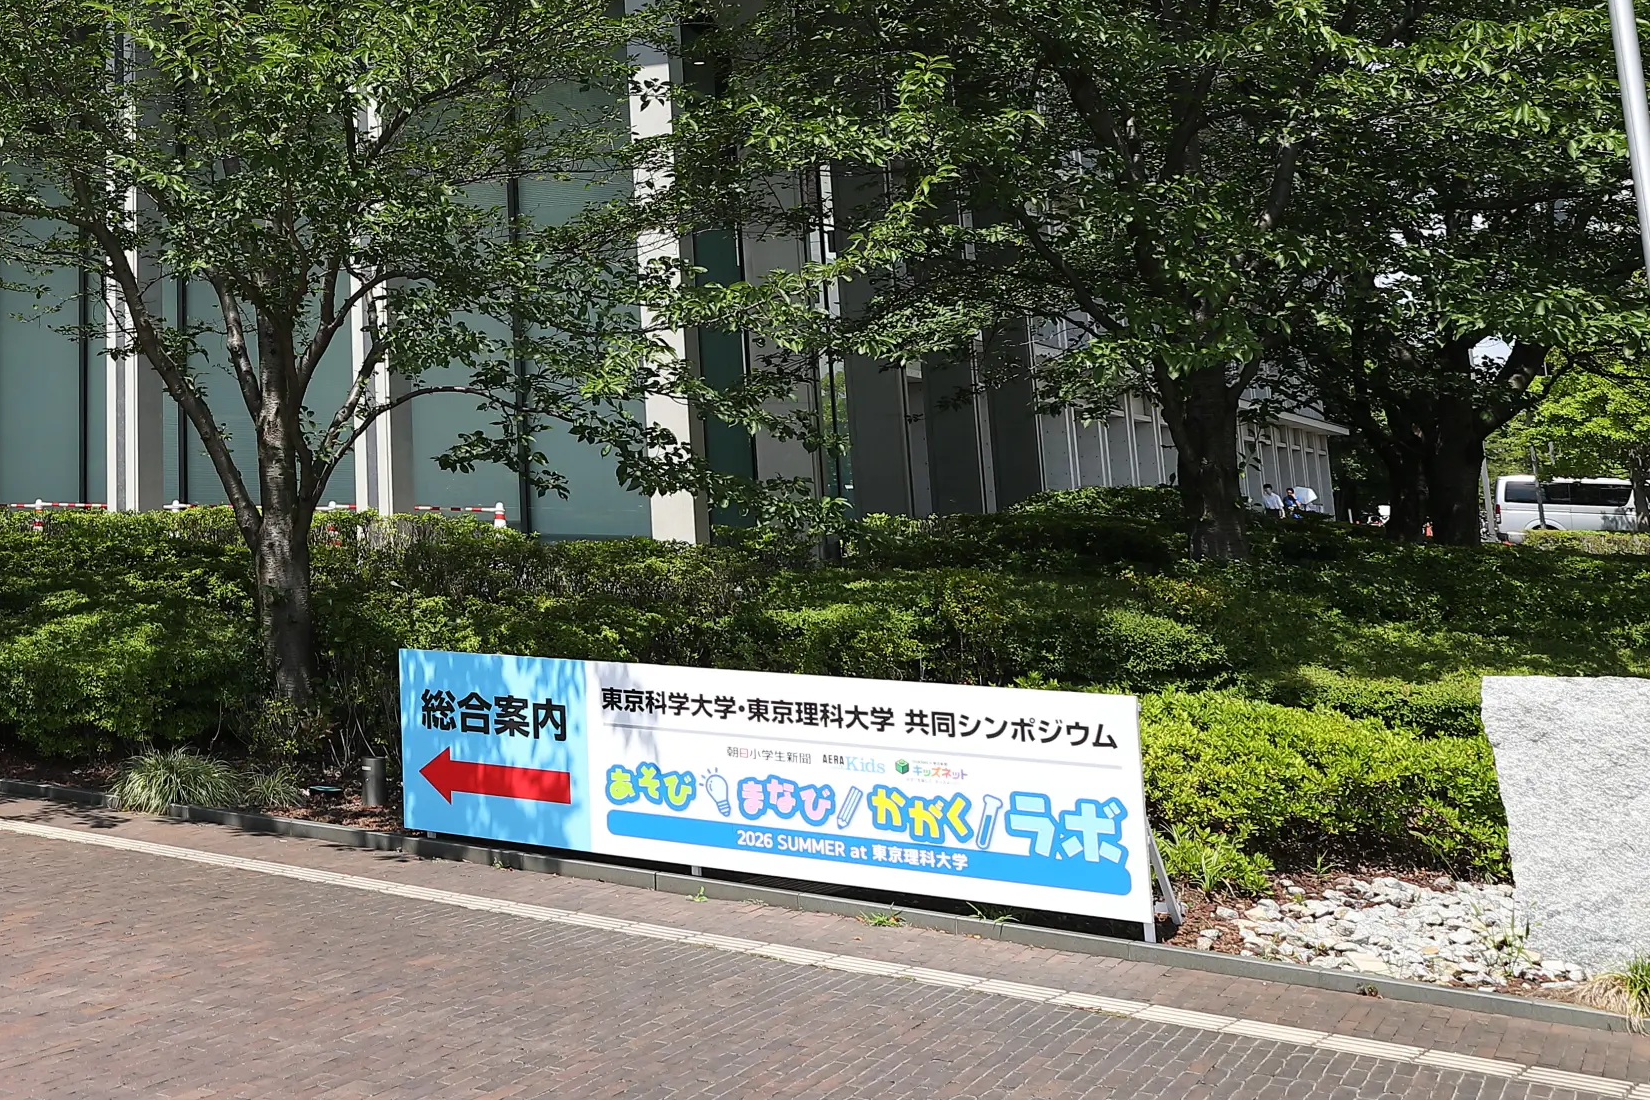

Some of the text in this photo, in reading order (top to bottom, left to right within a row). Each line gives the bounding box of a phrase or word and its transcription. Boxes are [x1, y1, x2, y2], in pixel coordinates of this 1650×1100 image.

[420, 688, 568, 742] 総合案内
[601, 687, 1118, 750] 東京科学大学・東京理科大学 共同シンポジウム
[727, 746, 812, 765] 朝日小学生新聞
[822, 753, 886, 774] AERA Kids
[913, 764, 968, 781] キッズネット
[608, 763, 1124, 864] あそび まなび かがく ラボ
[736, 829, 969, 872] 2026 SUMMER at 東京理科大学
